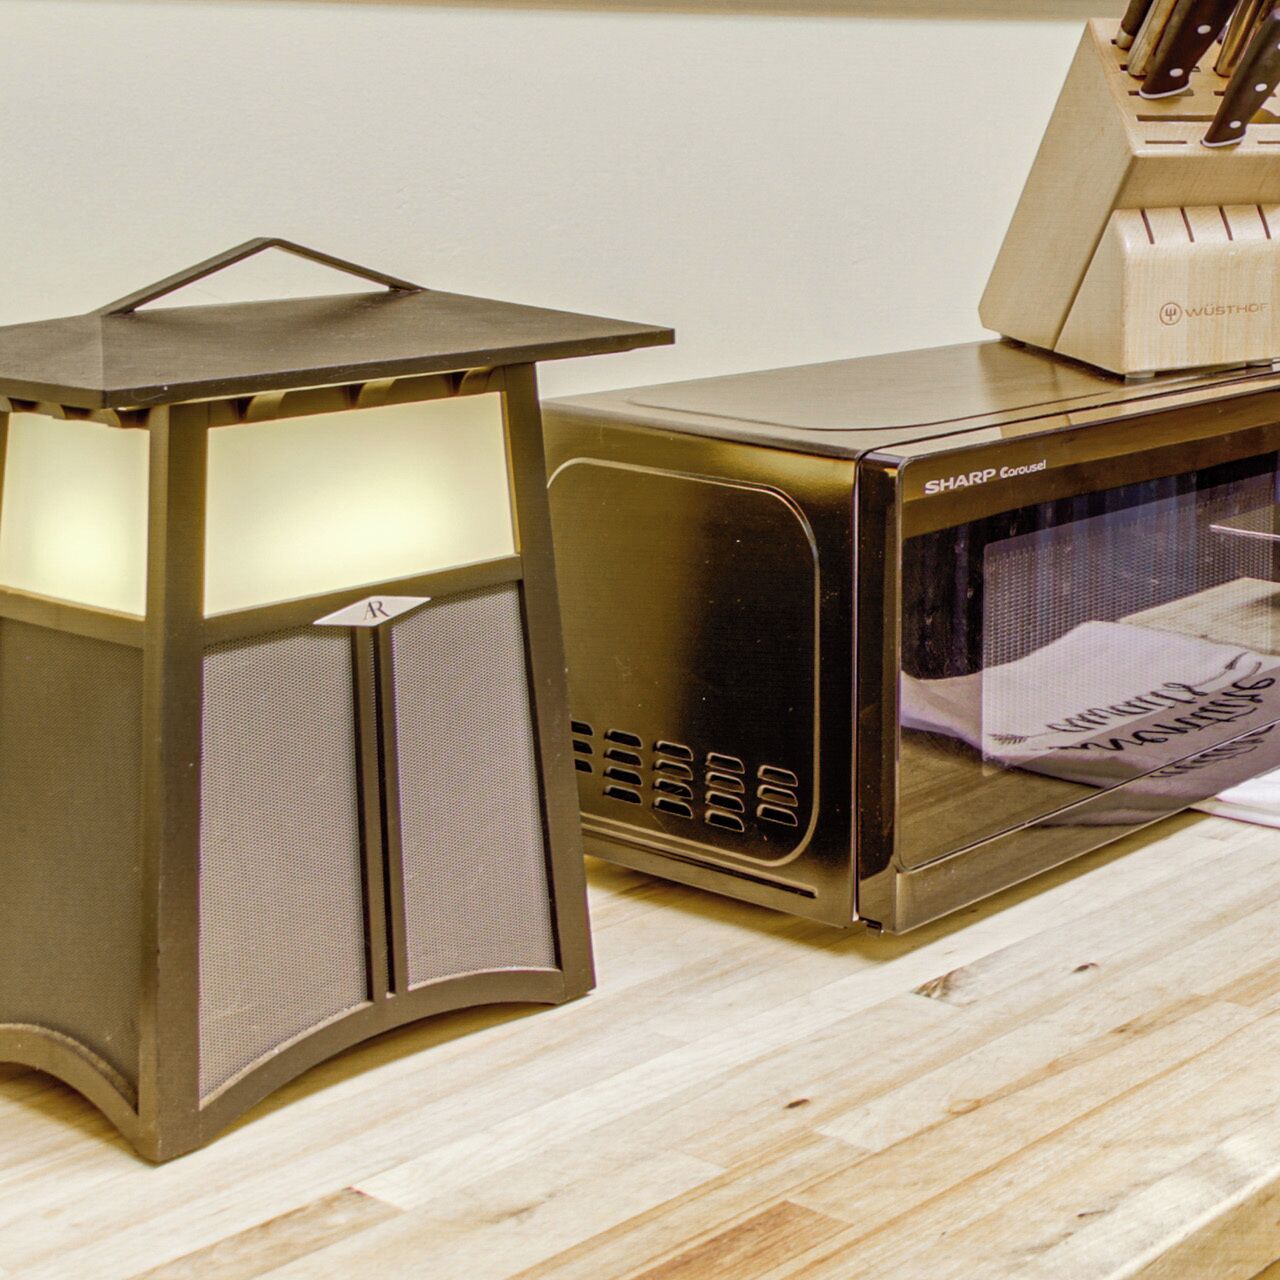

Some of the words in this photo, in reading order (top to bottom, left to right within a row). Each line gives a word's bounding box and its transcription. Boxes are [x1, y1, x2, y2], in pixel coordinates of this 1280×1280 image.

[1185, 301, 1271, 318] WÜSTHOF
[924, 467, 996, 496] SHARP
[999, 459, 1047, 480] Carousel
